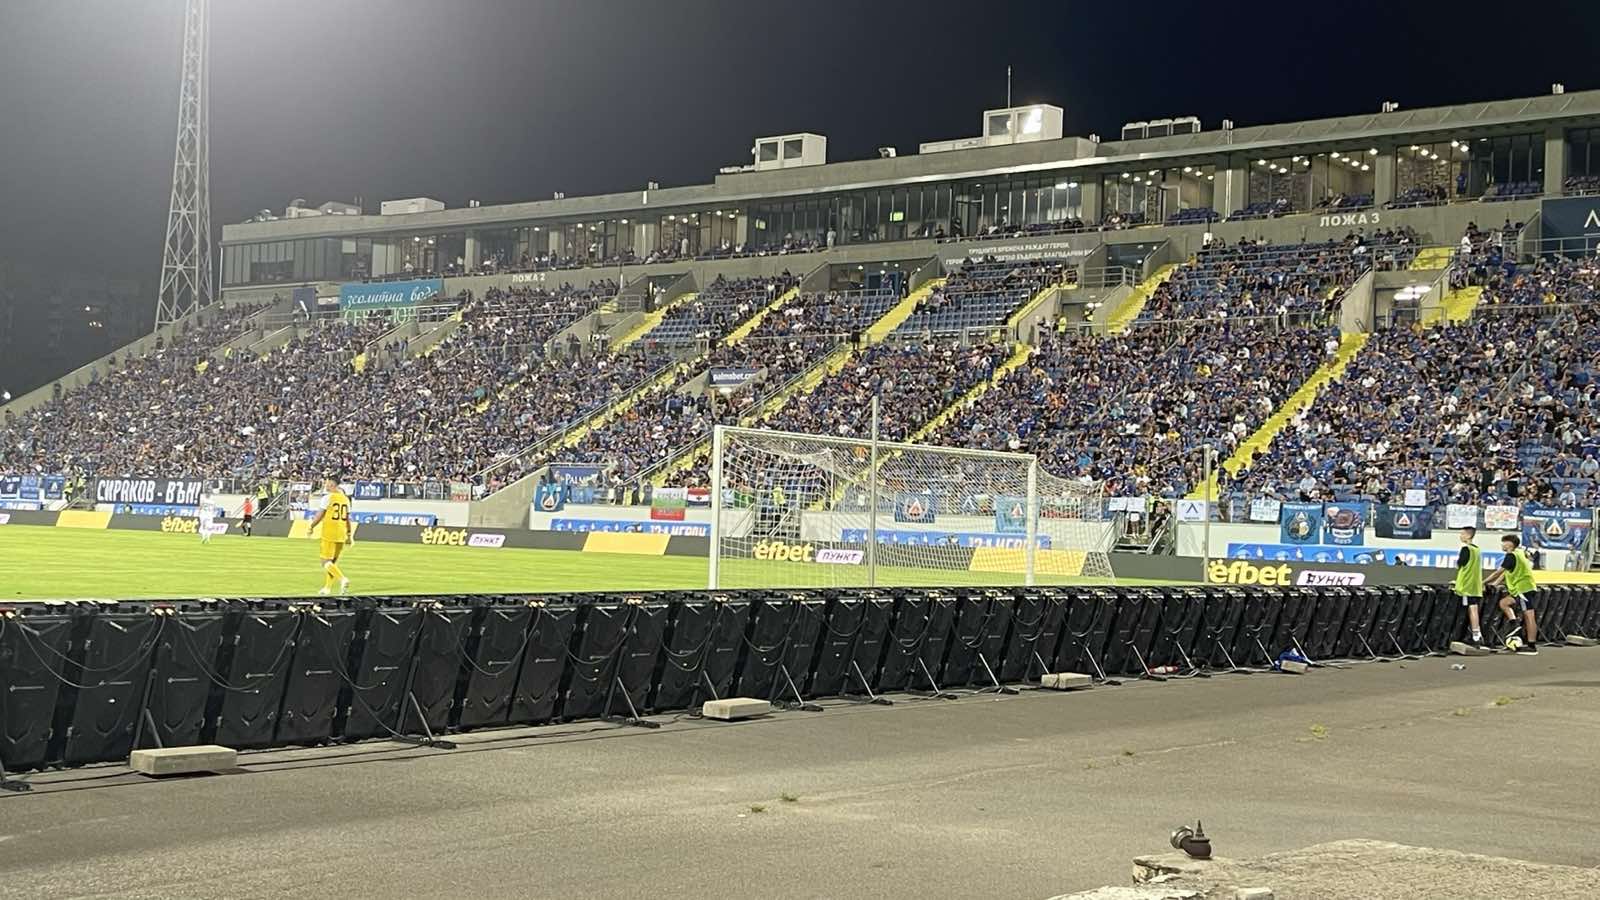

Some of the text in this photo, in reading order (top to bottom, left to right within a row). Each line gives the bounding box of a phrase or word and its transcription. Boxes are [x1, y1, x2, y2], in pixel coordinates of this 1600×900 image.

[1320, 212, 1380, 227] ЛОЖА 3
[512, 272, 546, 282] ЛОЖА 2
[97, 480, 156, 502] СИРАКОВ
[165, 481, 201, 504] ВЪН!
[331, 502, 348, 521] 30
[161, 516, 199, 534] efbet
[421, 527, 467, 545] efbet
[753, 539, 813, 562] efbet
[822, 551, 858, 561] ПУНКТ
[1208, 559, 1292, 585] efbet
[1307, 574, 1356, 585] ПУНКТ
